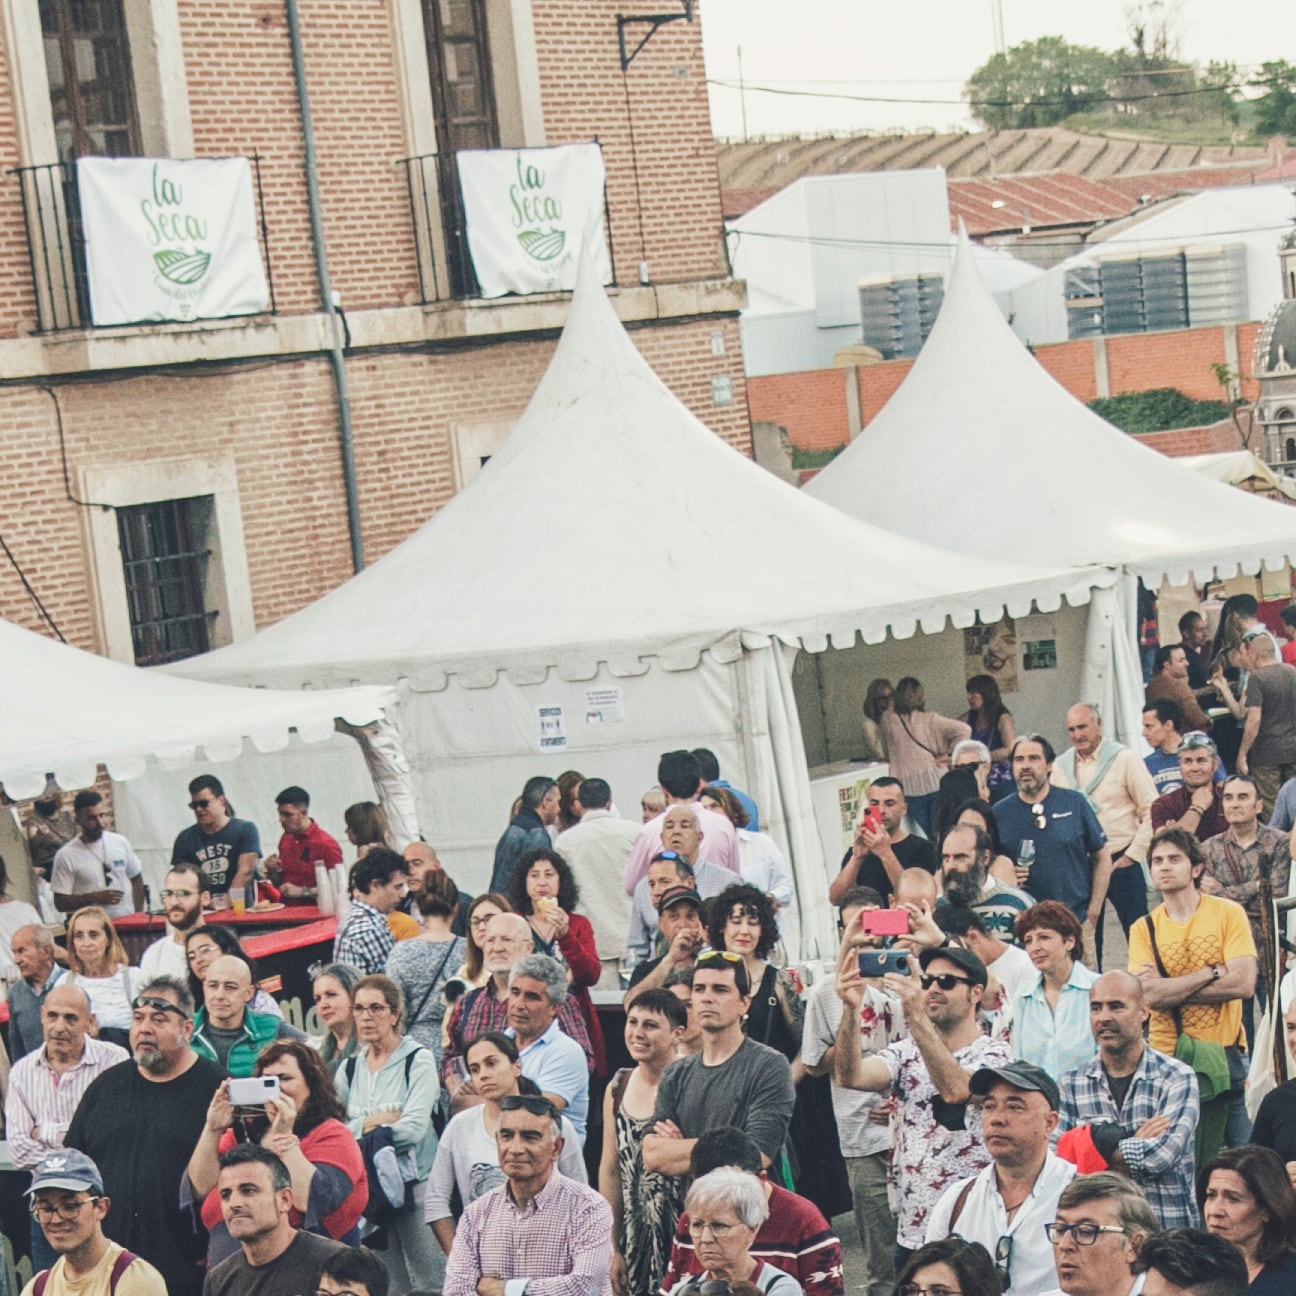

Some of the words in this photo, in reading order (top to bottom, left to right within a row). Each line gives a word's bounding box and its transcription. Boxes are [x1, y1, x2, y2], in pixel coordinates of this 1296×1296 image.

[152, 162, 182, 207] la
[517, 152, 545, 191] la
[140, 199, 207, 247] Seca
[510, 184, 562, 229] Seca
[195, 843, 232, 862] WEST
